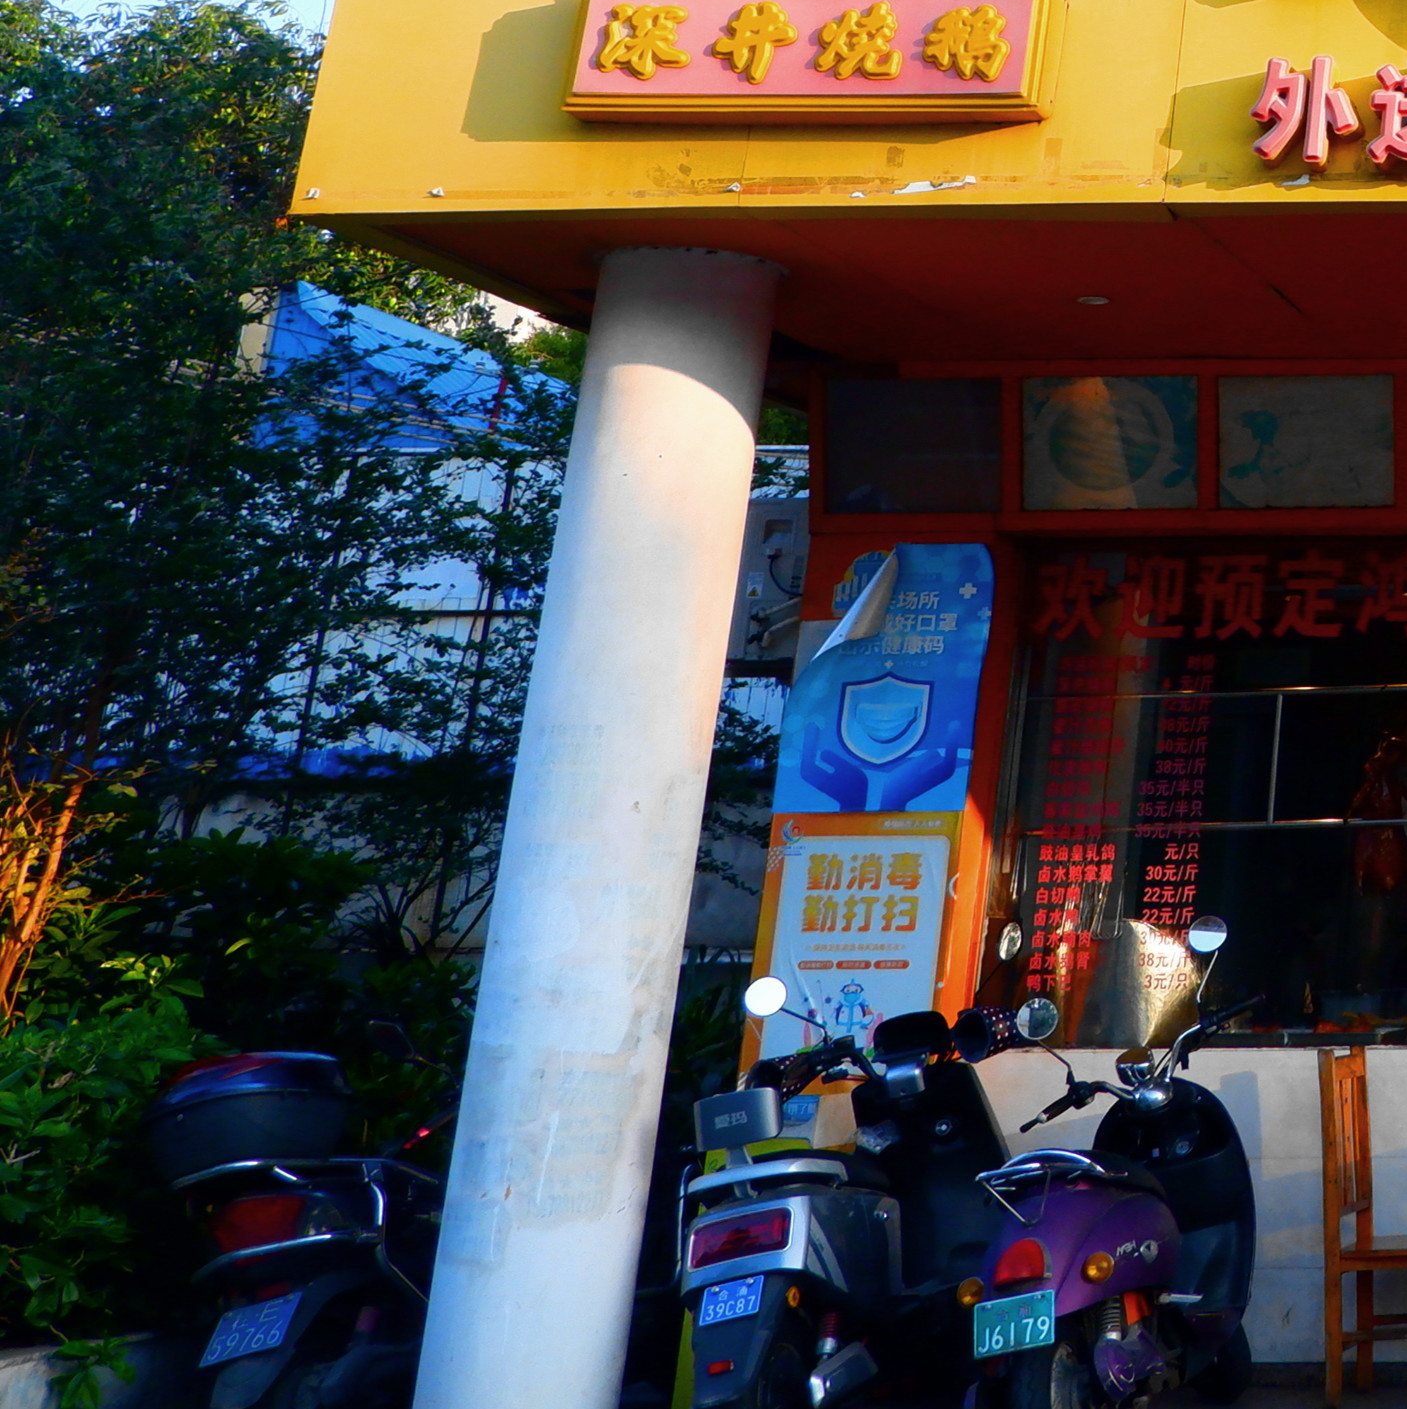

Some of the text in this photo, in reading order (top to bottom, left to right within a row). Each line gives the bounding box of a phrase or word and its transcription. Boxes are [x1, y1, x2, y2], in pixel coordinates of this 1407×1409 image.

[1136, 800, 1203, 817] 35元/半只
[1164, 843, 1200, 861] 元/只
[806, 852, 924, 890] 勤消毒
[1144, 864, 1199, 882] 30元/斤
[1143, 886, 1197, 903] 22元/斤
[801, 894, 920, 932] 勤打扫
[1141, 908, 1195, 925] 22元/斤
[1144, 973, 1188, 990] 3元/只
[705, 1294, 757, 1320] 39C87
[207, 1319, 284, 1361] 59766
[977, 1315, 1050, 1353] J6179
